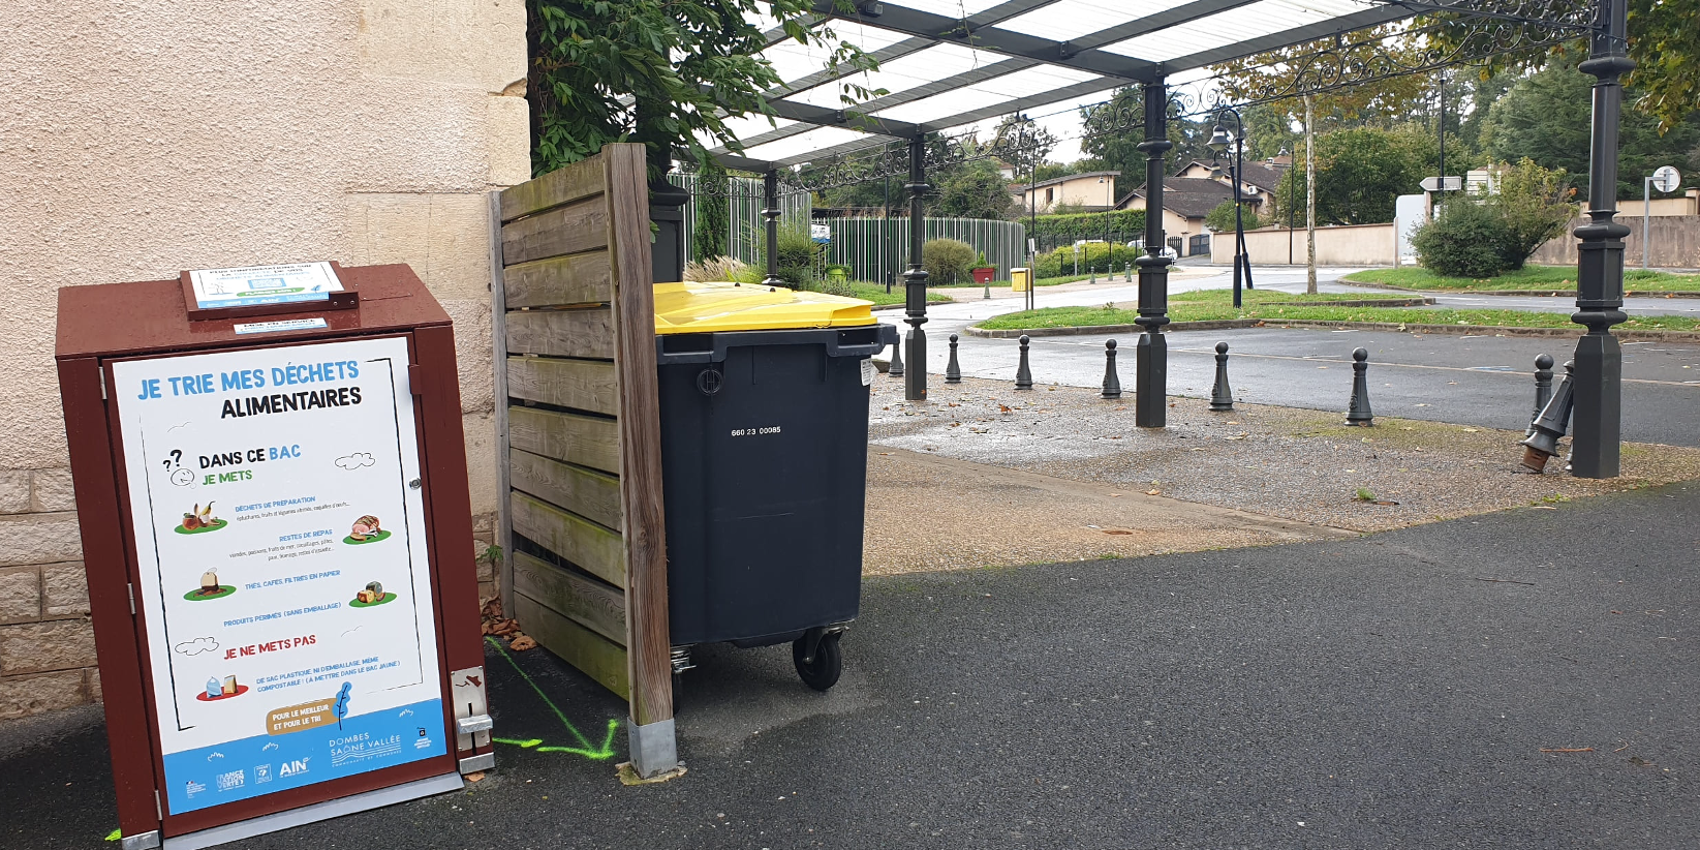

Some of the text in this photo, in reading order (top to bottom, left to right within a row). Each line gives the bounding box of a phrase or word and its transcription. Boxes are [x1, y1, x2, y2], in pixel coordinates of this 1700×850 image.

[138, 360, 359, 400] JE TRIE MES DÉCHETS
[220, 386, 362, 419] ALIMENTAIRES
[759, 426, 781, 435] 00085
[199, 444, 301, 469] DANS CE BAC
[202, 470, 252, 486] JE METS
[279, 533, 302, 542] RESTES
[312, 529, 333, 538] REPAS
[284, 574, 308, 584] FILTRES
[319, 570, 341, 578] PAPIER
[223, 616, 253, 627] PRODUITS
[283, 608, 303, 617] (SANS
[303, 602, 342, 614] EMBALLAGE)
[224, 634, 317, 660] JE NE METS PAS
[257, 680, 301, 692] COMPOSTABLE
[314, 671, 340, 682] METTRE
[340, 668, 357, 677] DANS
[358, 666, 365, 674] LE
[366, 663, 378, 672] BAC
[379, 660, 401, 670] JAUNE)
[266, 675, 279, 683] SAC
[272, 704, 330, 721] POUR LE MEILLEUR
[274, 715, 322, 731] ET POUR LE TRI
[329, 732, 370, 748] DOMBES
[330, 743, 365, 757] SAÔNE
[368, 735, 401, 748] VALLÉE
[280, 759, 307, 776] AIN
